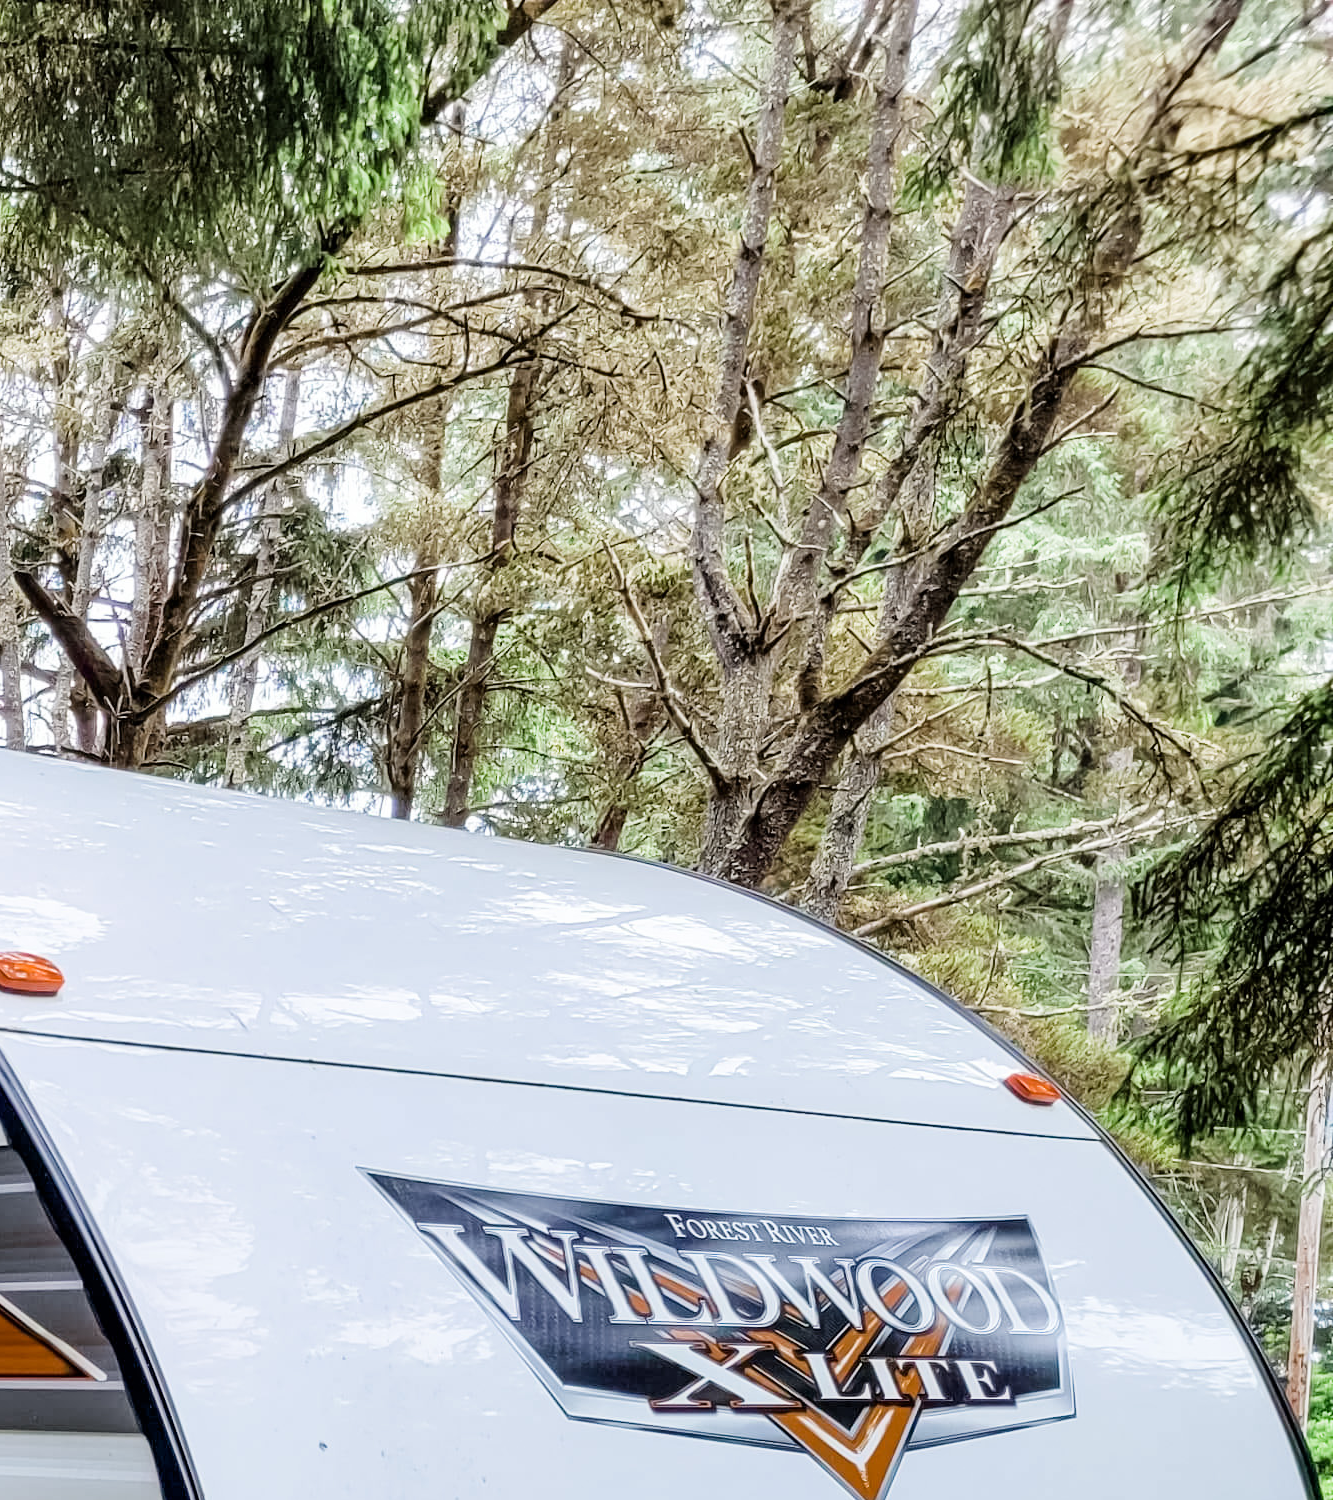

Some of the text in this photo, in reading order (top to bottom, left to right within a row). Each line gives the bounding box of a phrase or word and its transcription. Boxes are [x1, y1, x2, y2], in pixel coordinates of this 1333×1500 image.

[663, 1213, 840, 1247] FOREST RIVER
[417, 1222, 1063, 1336] WILDWOOD
